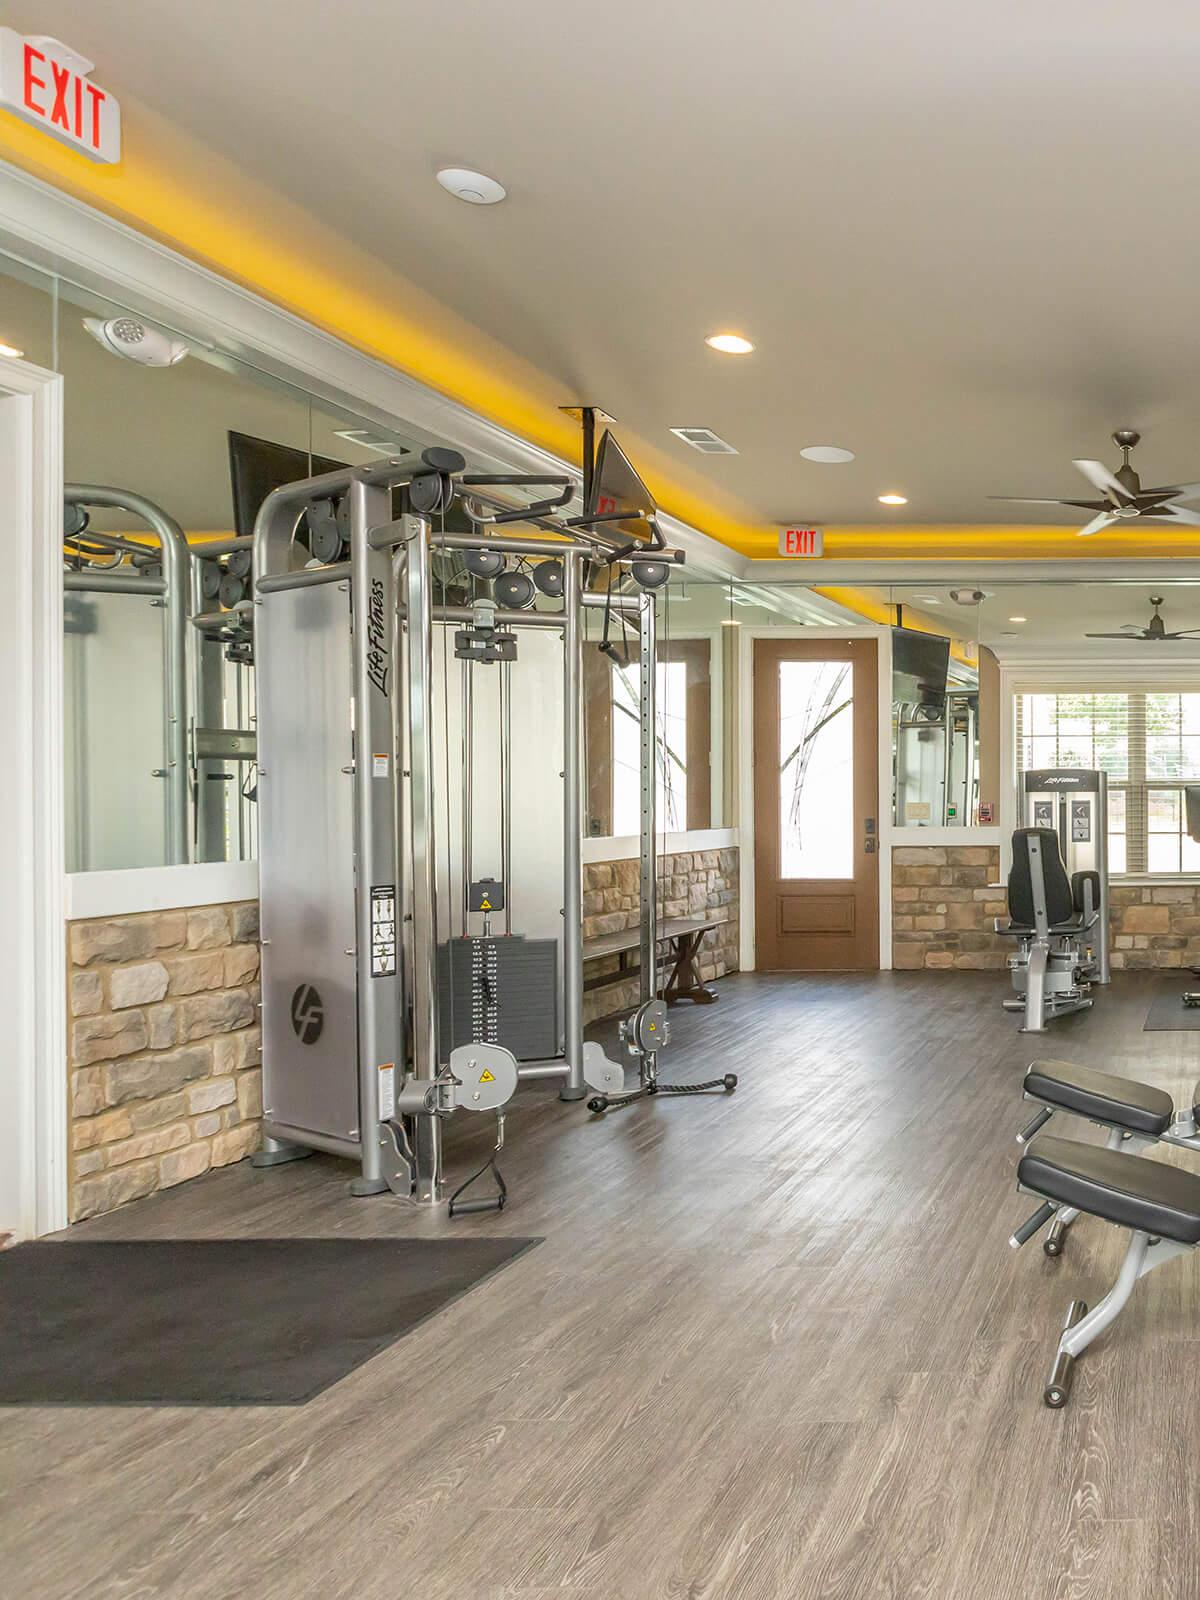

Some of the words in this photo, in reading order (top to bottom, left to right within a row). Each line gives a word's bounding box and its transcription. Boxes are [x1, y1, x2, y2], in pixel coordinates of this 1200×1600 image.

[23, 43, 106, 150] EXIT
[785, 530, 817, 554] EXIT
[367, 578, 389, 655] Fitness
[367, 651, 388, 698] Life
